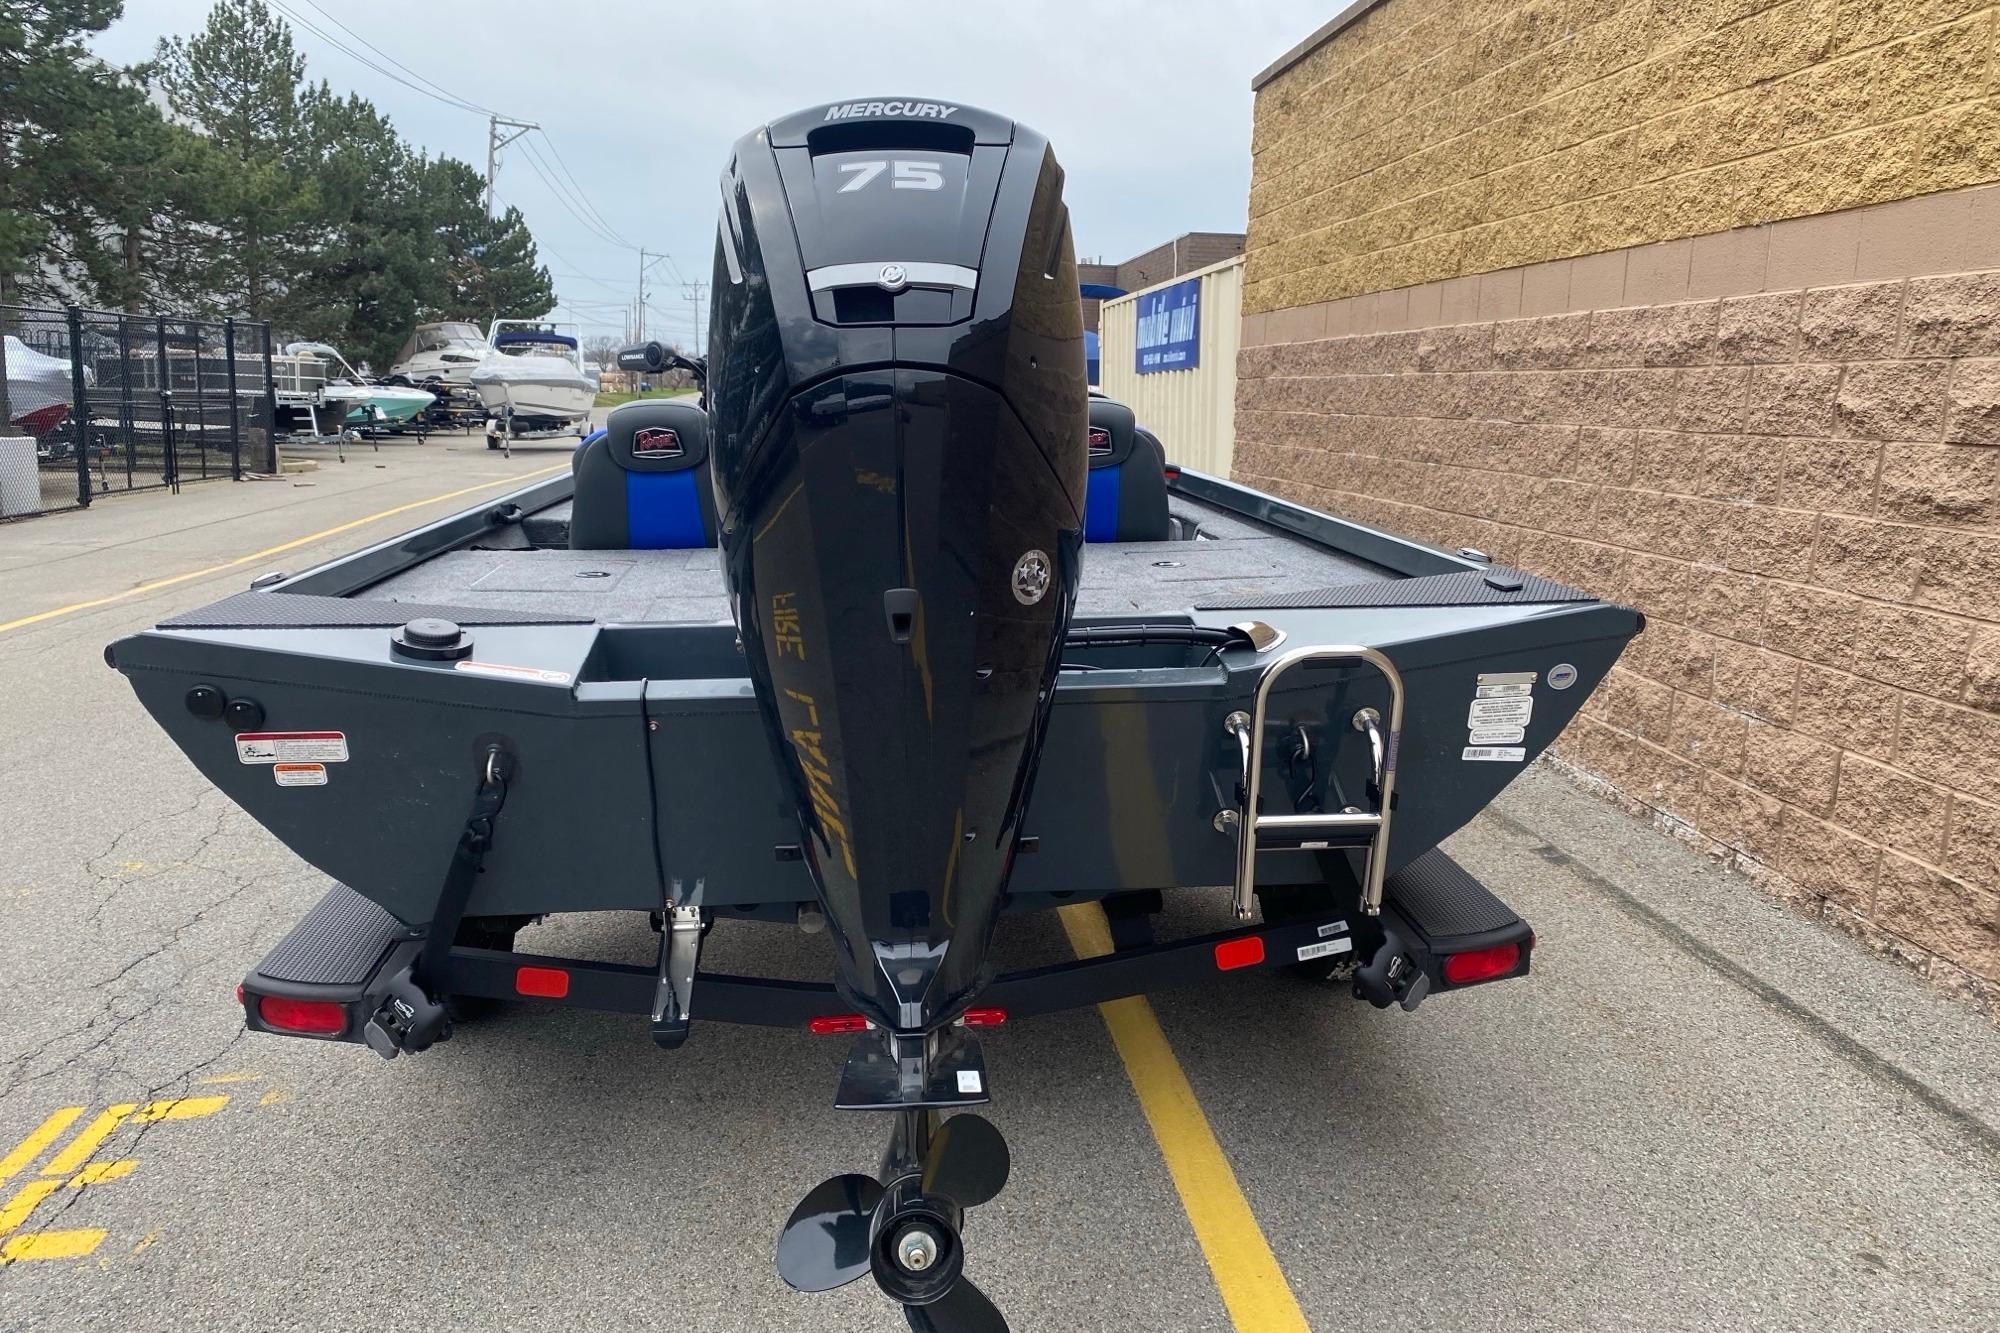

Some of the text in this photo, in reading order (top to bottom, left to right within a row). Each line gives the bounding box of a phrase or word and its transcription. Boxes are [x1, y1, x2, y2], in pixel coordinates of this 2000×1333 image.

[824, 102, 958, 121] MERCURY
[836, 160, 945, 194] 75
[1137, 294, 1198, 350] mobile mini
[621, 353, 644, 361] LOWRANCE
